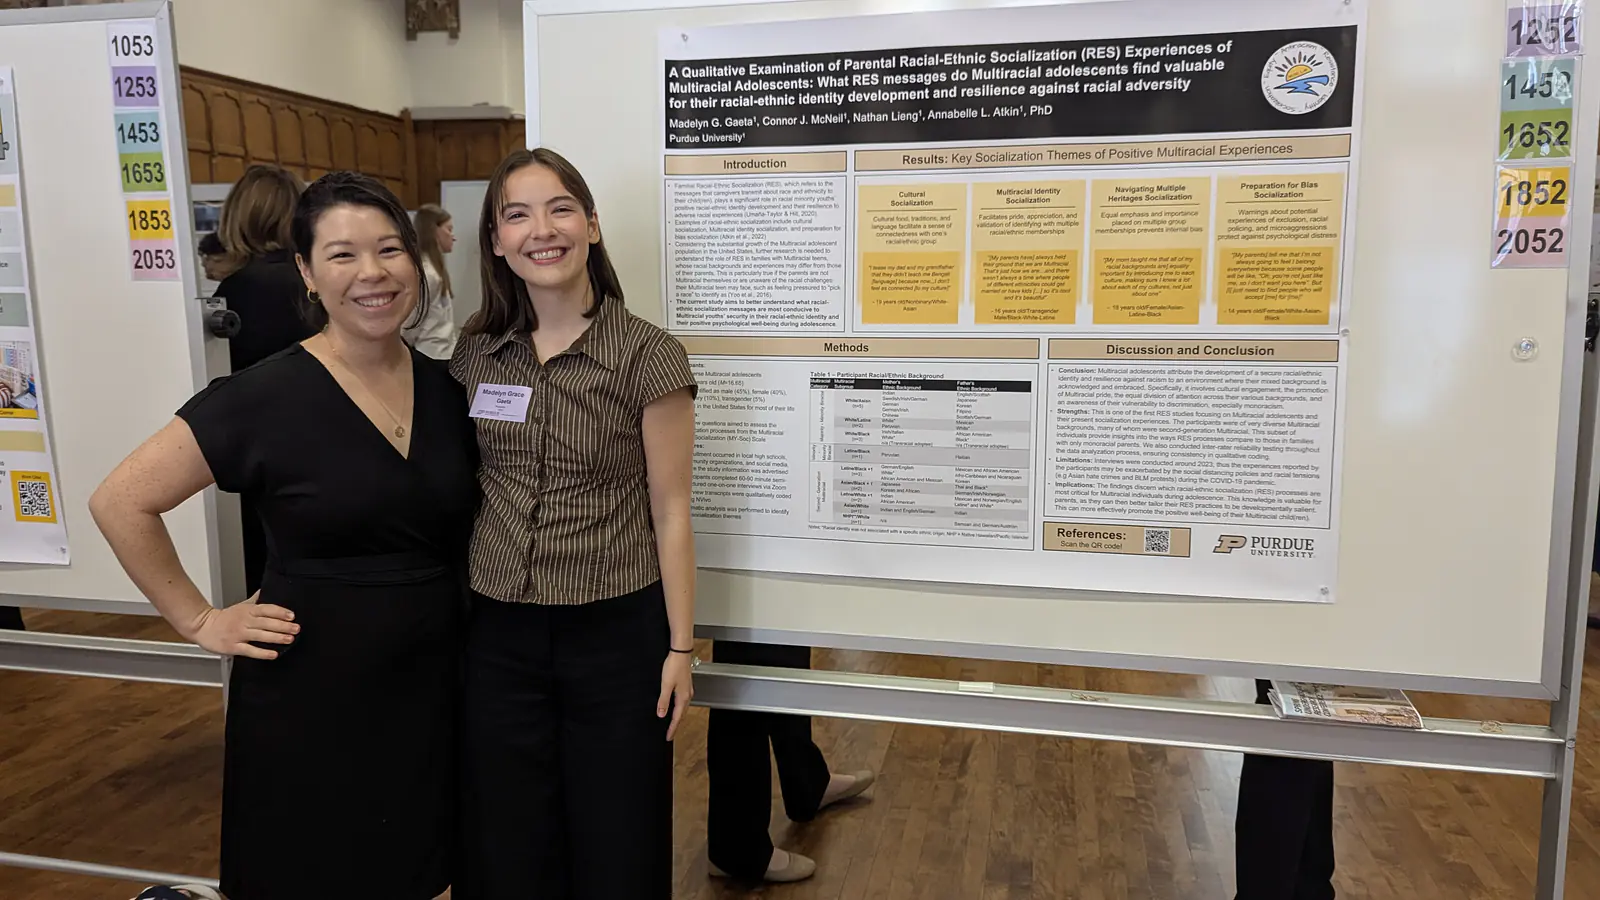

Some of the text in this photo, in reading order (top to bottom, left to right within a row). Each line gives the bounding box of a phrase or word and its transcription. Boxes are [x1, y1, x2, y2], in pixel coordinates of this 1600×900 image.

[1512, 16, 1576, 46] 1252
[111, 35, 154, 56] 1053
[669, 41, 1232, 77] A Qualitative Examination of Parental Racial-Ethnic Socialization (RES) Experiences of
[669, 59, 1224, 93] Multiracial Adolescents: What RES messages do Multiracial adolescents find valuable
[114, 76, 156, 98] 1253
[669, 79, 1190, 108] for their racial-ethnic identity development and resilience against racial adversity
[669, 118, 708, 130] Madelyn
[710, 117, 722, 127] G.
[762, 115, 797, 126] Connor
[799, 114, 809, 124] J.
[852, 111, 888, 122] Nathan
[927, 108, 978, 120] Annabelle
[980, 107, 990, 118] L.
[1029, 105, 1052, 117] PhD
[118, 122, 160, 144] 1453
[669, 134, 700, 143] Purdue
[1503, 120, 1569, 148] 1652
[723, 158, 786, 170] Introduction
[902, 144, 1293, 165] Results: Key Socialization Themes of Positive Multiracial Experiences
[122, 162, 164, 184] 1653
[1115, 184, 1185, 194] Navigating Multiple
[1240, 182, 1286, 190] Preparation
[1502, 180, 1567, 206] 1852
[1108, 194, 1143, 203] Heritages
[129, 210, 171, 231] 1853
[1496, 228, 1564, 254] 2052
[133, 249, 176, 270] 2053
[824, 343, 869, 352] Methods
[1106, 344, 1274, 356] Discussion and Conclusion
[482, 389, 506, 397] Madelyn
[1057, 528, 1126, 540] References:
[1251, 536, 1314, 551] PURDUE
